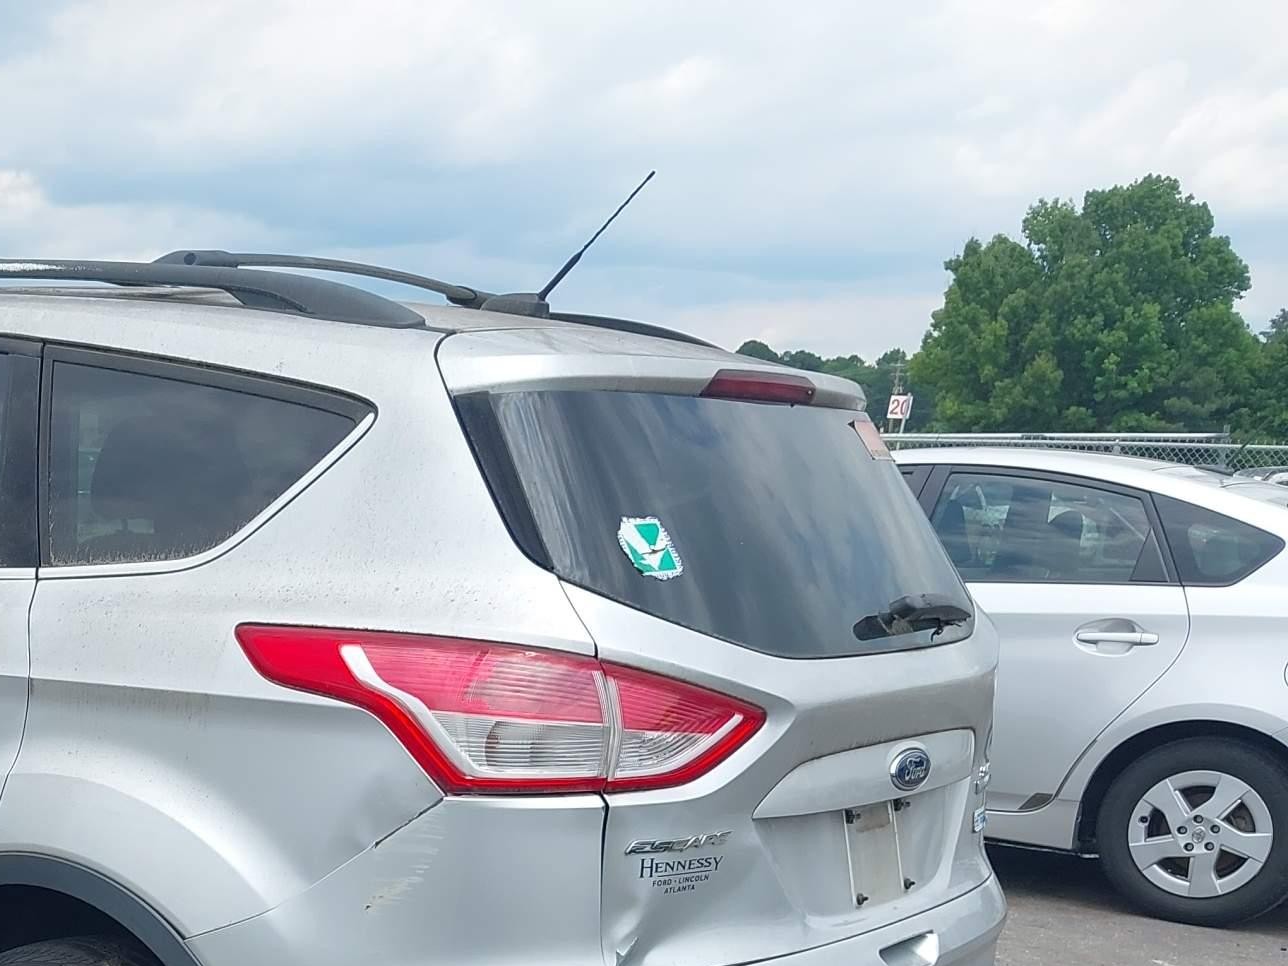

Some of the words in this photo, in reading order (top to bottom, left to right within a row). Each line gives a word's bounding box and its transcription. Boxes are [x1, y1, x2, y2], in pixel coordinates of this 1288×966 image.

[889, 398, 910, 415] 20
[639, 856, 724, 878] HENNESSY
[652, 879, 672, 887] FORD
[678, 875, 710, 884] LINCOLN
[664, 884, 695, 894] ATLANTA
